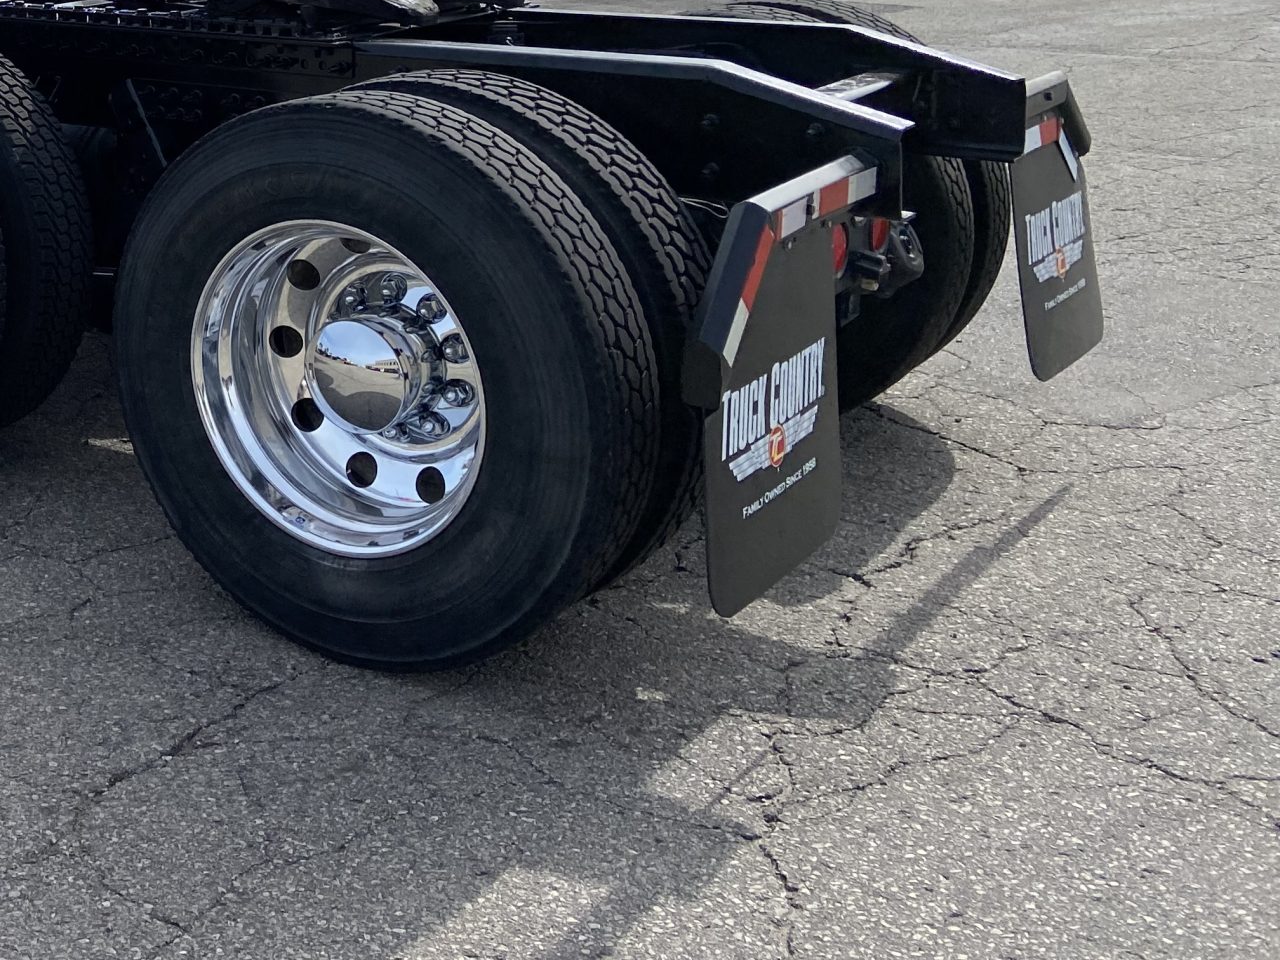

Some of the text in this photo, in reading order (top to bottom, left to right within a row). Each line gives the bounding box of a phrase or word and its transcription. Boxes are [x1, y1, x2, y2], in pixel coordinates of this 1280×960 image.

[1025, 190, 1084, 265] TRUCK COUNTRY
[722, 336, 826, 462] TRUCK COUNTRY
[742, 497, 764, 519] FAMILY
[764, 482, 786, 503] OWNED
[785, 469, 803, 488] SINCE
